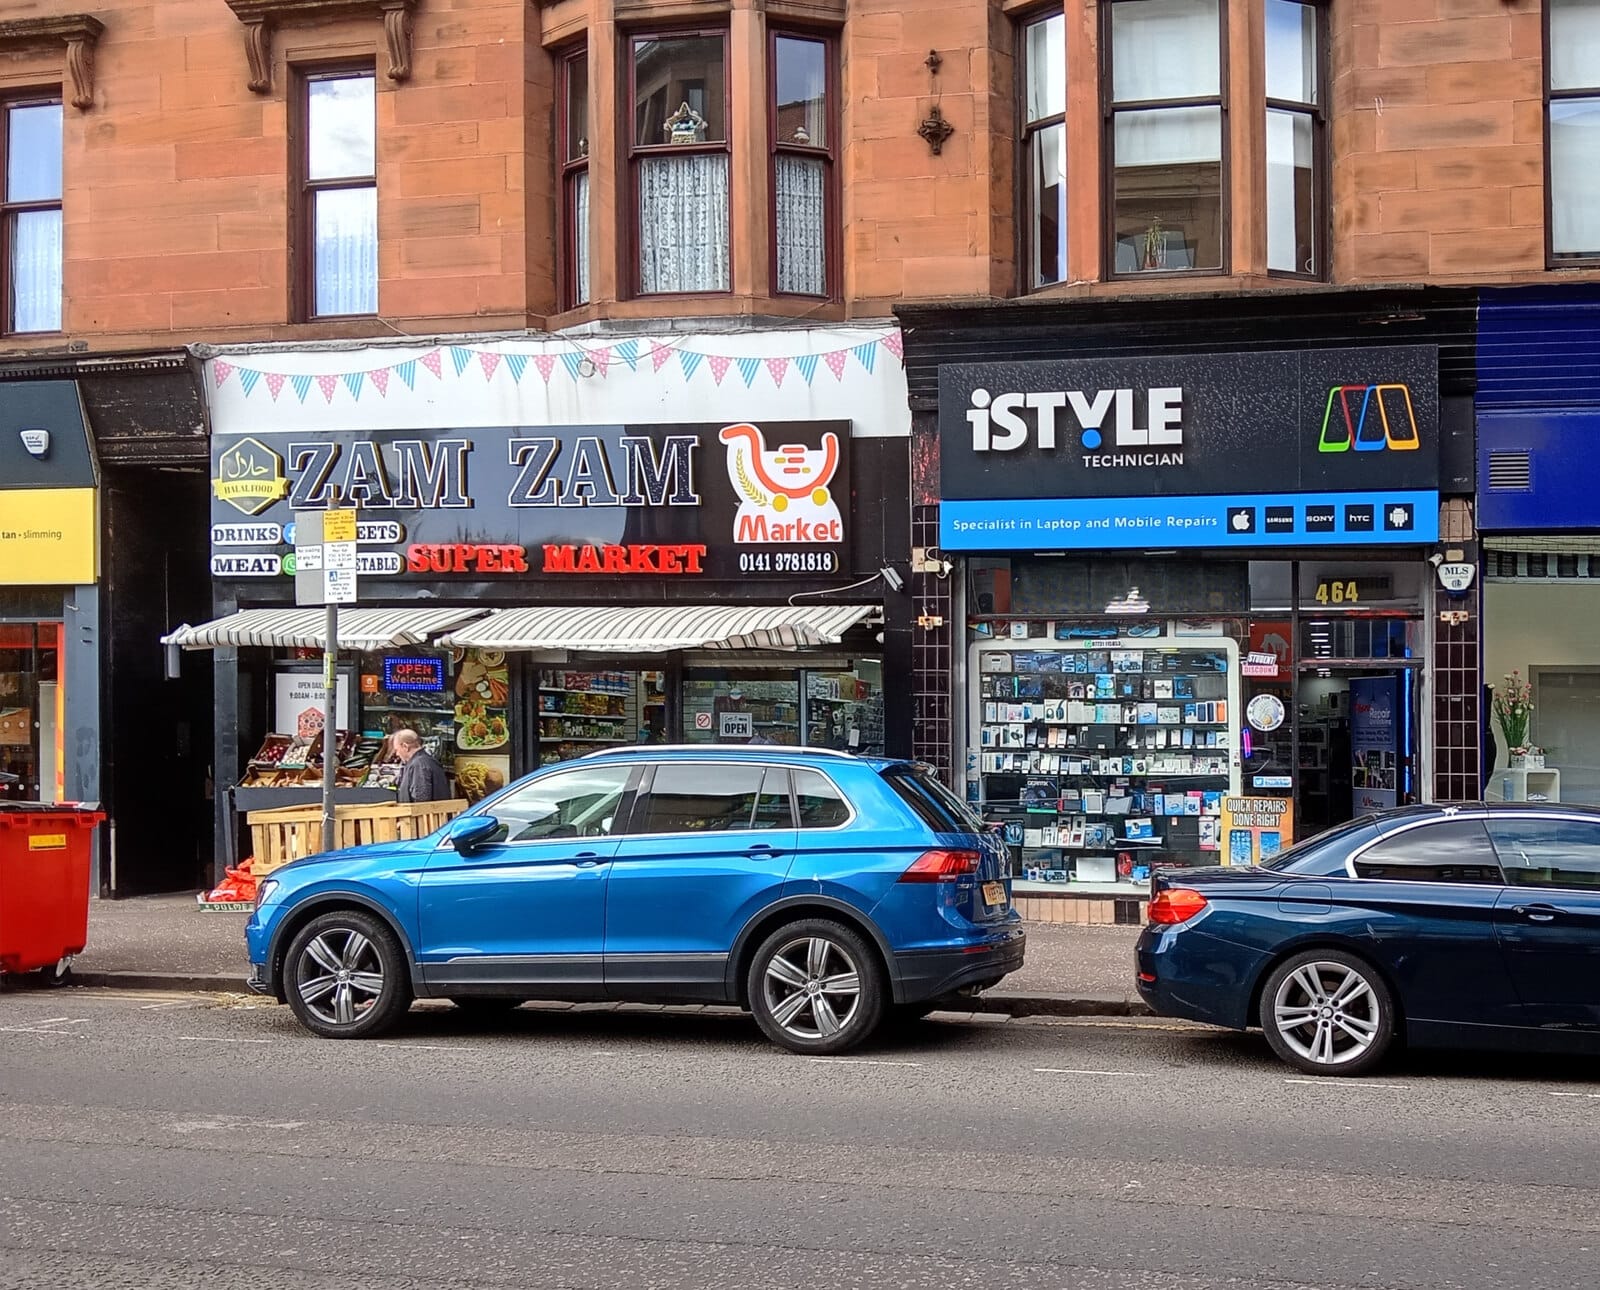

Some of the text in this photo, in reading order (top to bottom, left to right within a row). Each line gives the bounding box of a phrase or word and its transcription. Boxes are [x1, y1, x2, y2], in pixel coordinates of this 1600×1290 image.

[966, 387, 1183, 451] iSTYLE
[226, 451, 269, 479] حلال
[1082, 453, 1184, 468] TECHNICIAN
[288, 435, 701, 509] ZAM ZAM
[251, 484, 273, 493] FOOD
[738, 515, 840, 541] Market
[953, 515, 1217, 532] Specialist in Laptop and Mobile Repairs
[23, 530, 62, 540] slimming
[213, 528, 279, 542] DRINKS
[356, 525, 398, 540] EETS
[214, 558, 278, 573] MEAT
[356, 557, 398, 571] ETABLE
[407, 543, 708, 574] SUPER MARKET
[739, 552, 832, 571] 0141 3781818
[1444, 567, 1469, 575] MLS
[1315, 582, 1358, 605] 464
[396, 664, 432, 674] OPEN
[390, 674, 438, 685] Welcome
[725, 723, 748, 734] OPEN
[1227, 799, 1287, 813] QUICK REPAIRS
[1233, 813, 1280, 826] DONE RIGHT
